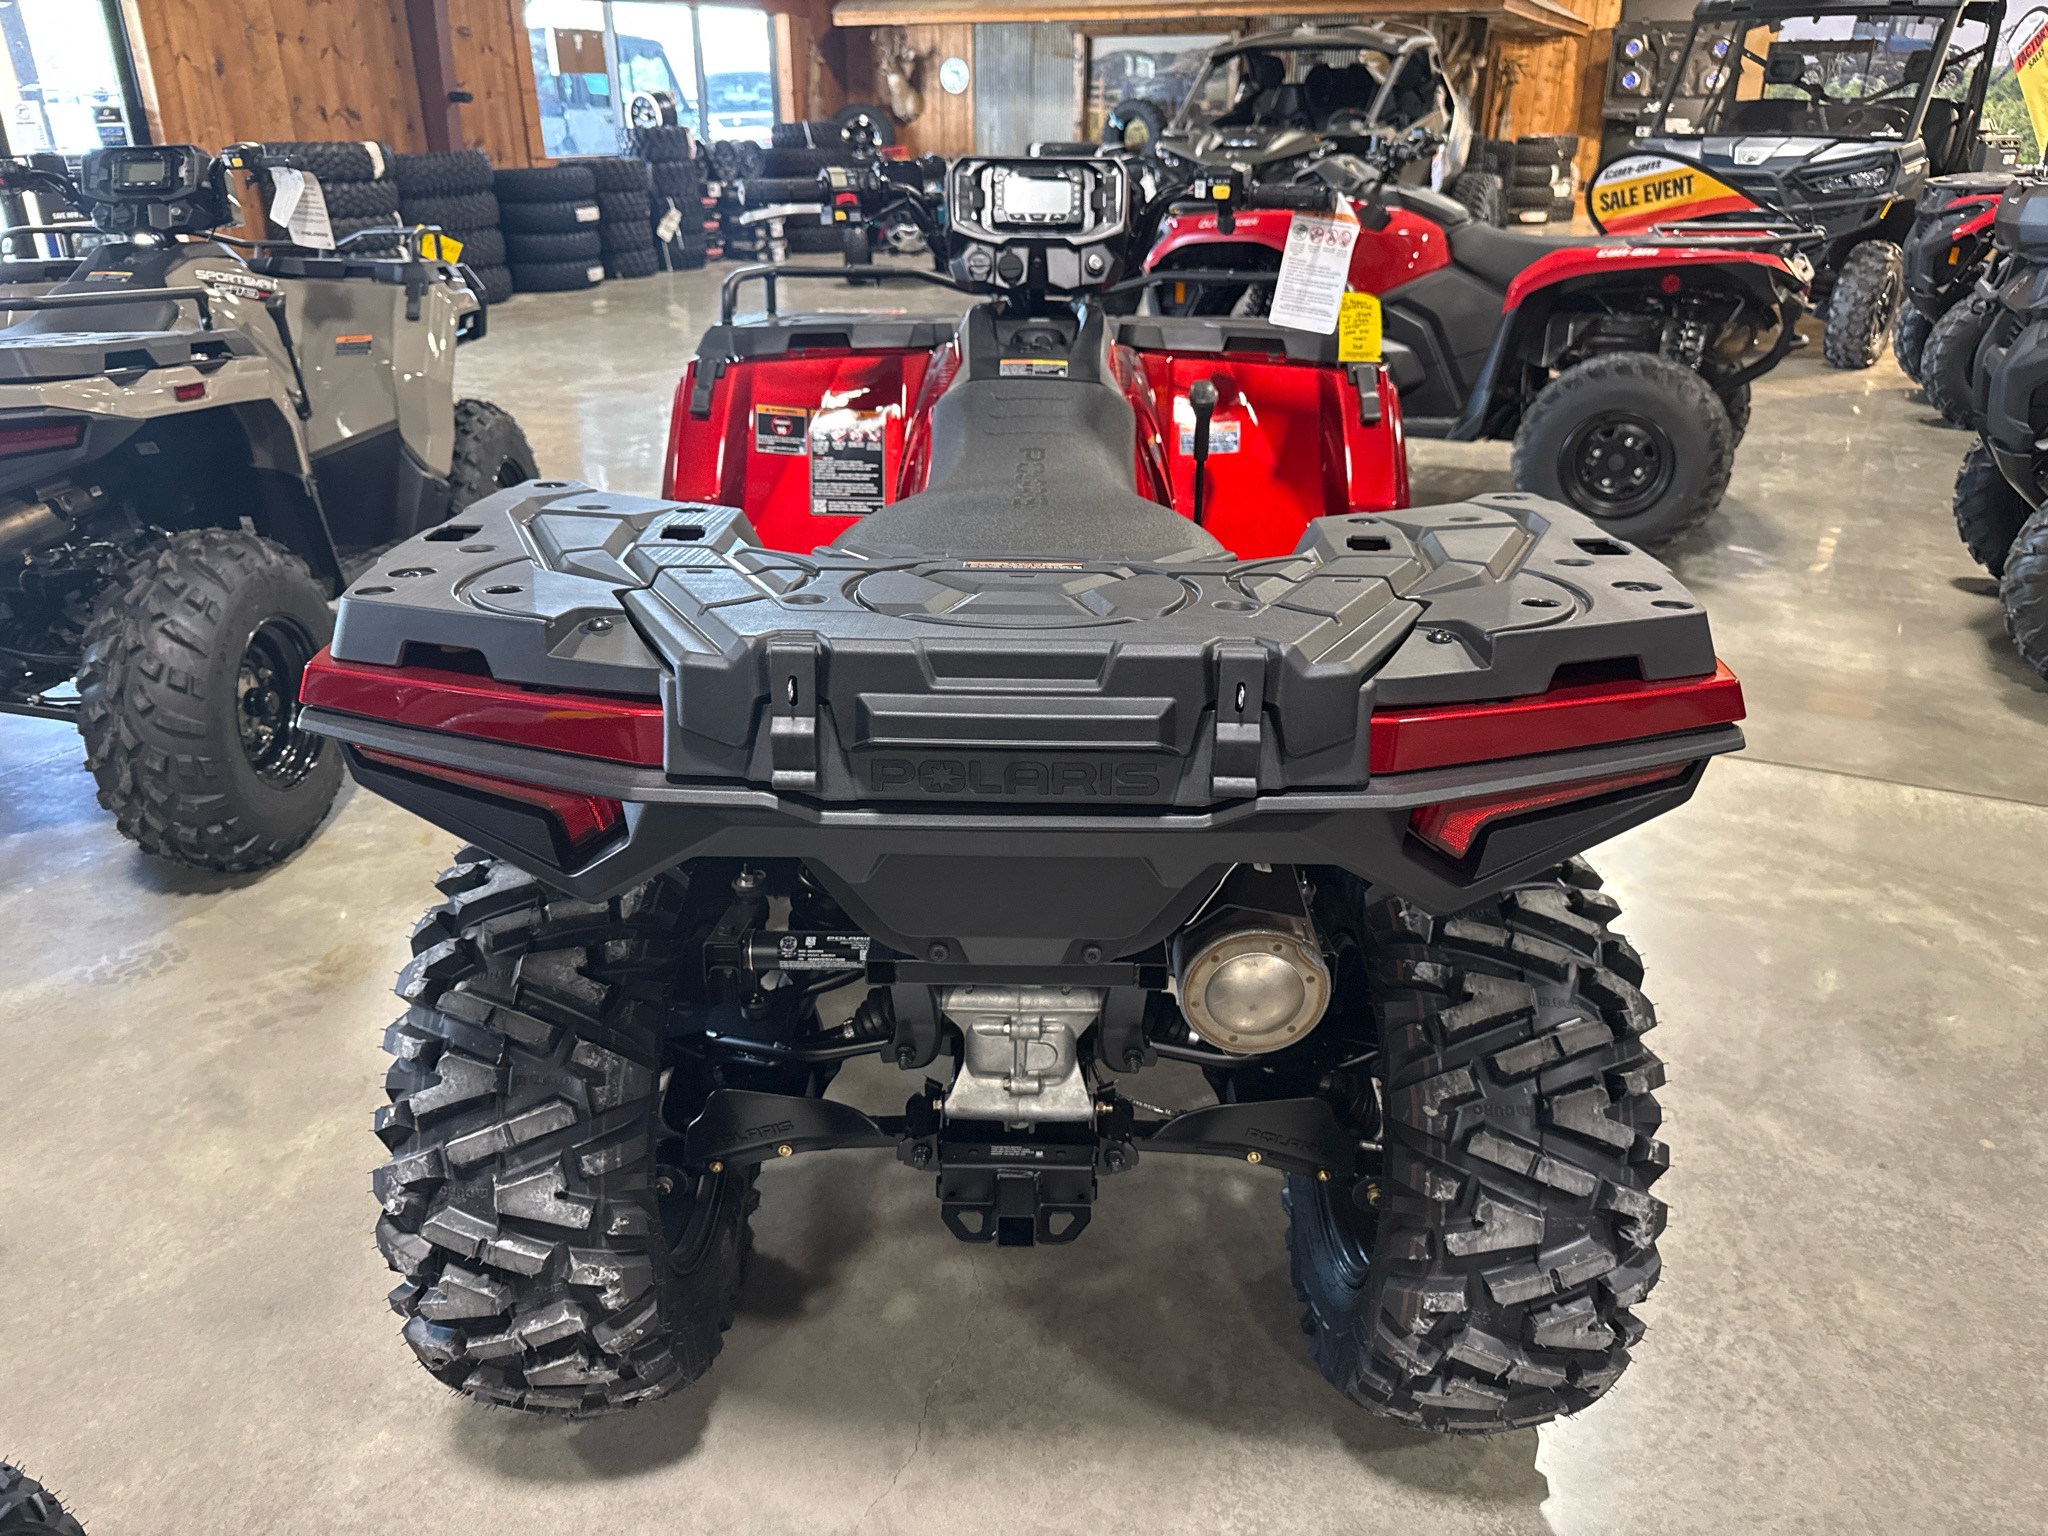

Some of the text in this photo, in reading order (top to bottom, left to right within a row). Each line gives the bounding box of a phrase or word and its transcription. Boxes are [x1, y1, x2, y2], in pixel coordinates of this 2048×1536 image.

[1600, 174, 1695, 212] SALE EVENT
[870, 758, 1160, 797] POLARIS
